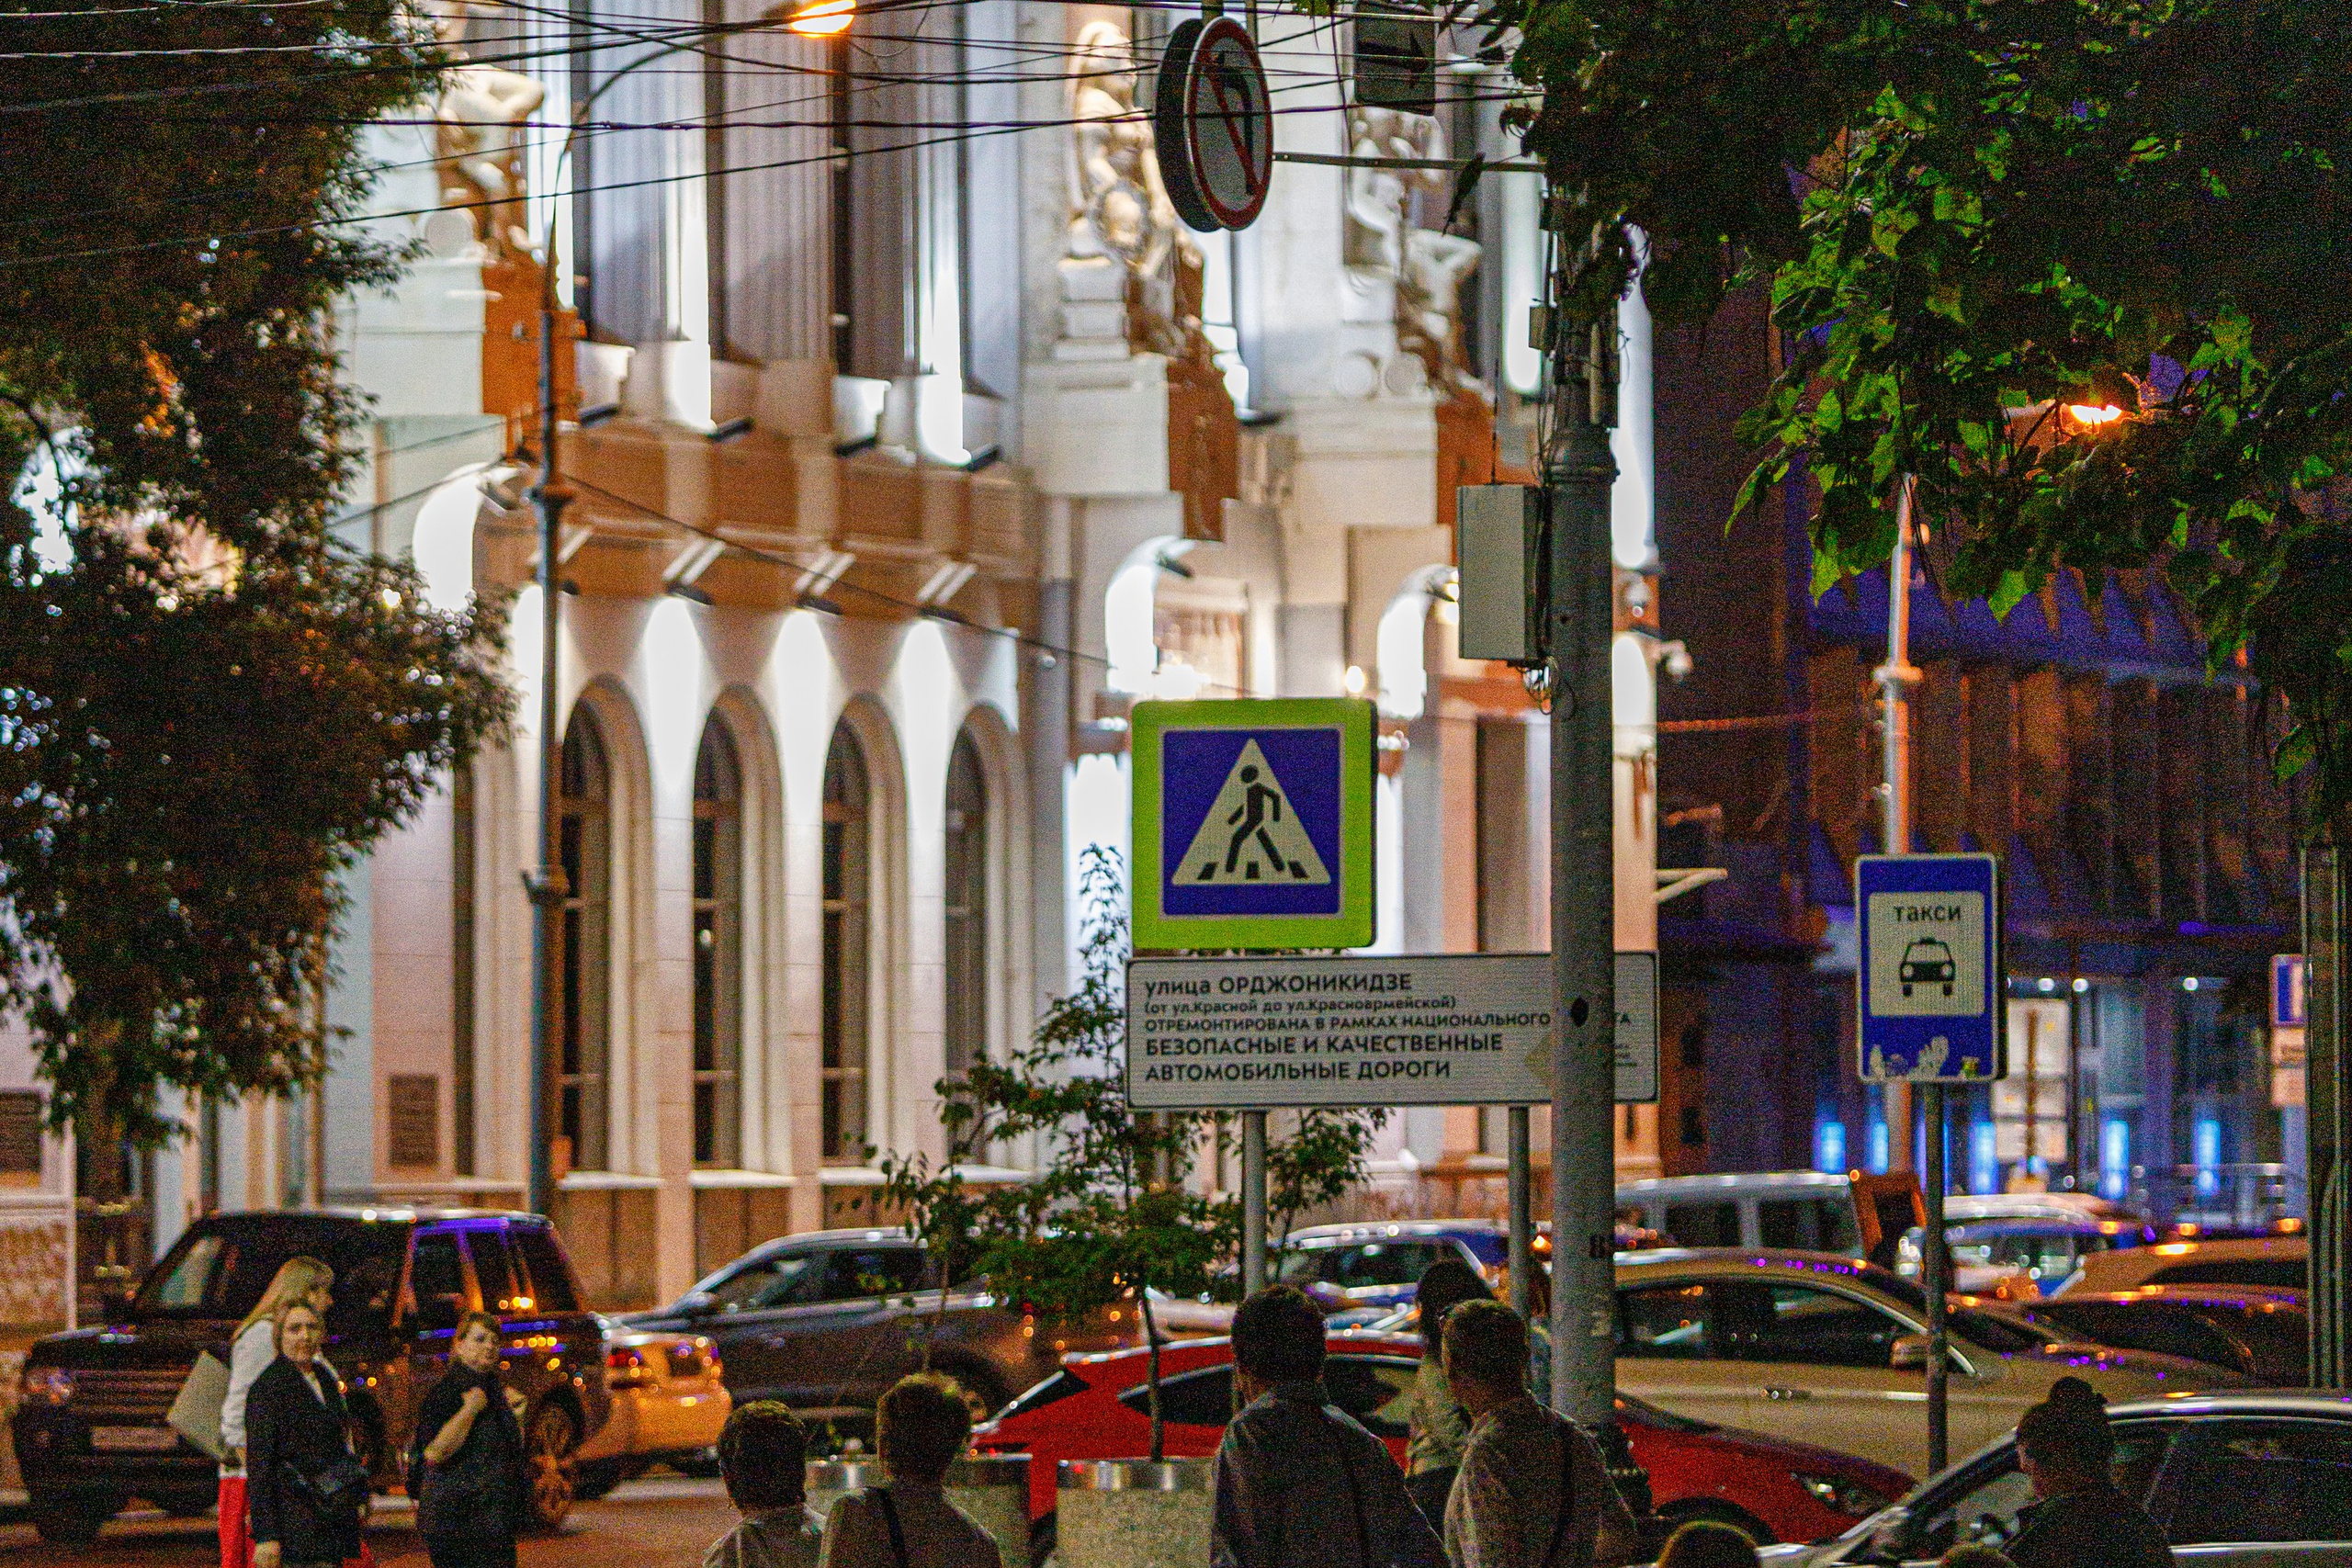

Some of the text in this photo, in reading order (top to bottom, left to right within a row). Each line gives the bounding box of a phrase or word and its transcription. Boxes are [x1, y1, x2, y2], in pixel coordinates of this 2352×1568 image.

[1894, 905, 1962, 922] такси
[1145, 972, 1412, 1000] улица ОРДЖОНИКИДЗЕ
[1262, 1000, 1283, 1012] до
[1145, 1012, 1551, 1032] ОТРЕМОНТИРОВАНА В РАМКАХ НАЦИОНАЛЬНОГО
[1146, 1033, 1504, 1055] БЕЗОПАСНЫЕ И КАЧЕСТВЕННЫЕ
[1145, 1060, 1452, 1081] АВТОМОБИЛЬНЫЕ ДОРОГИ
